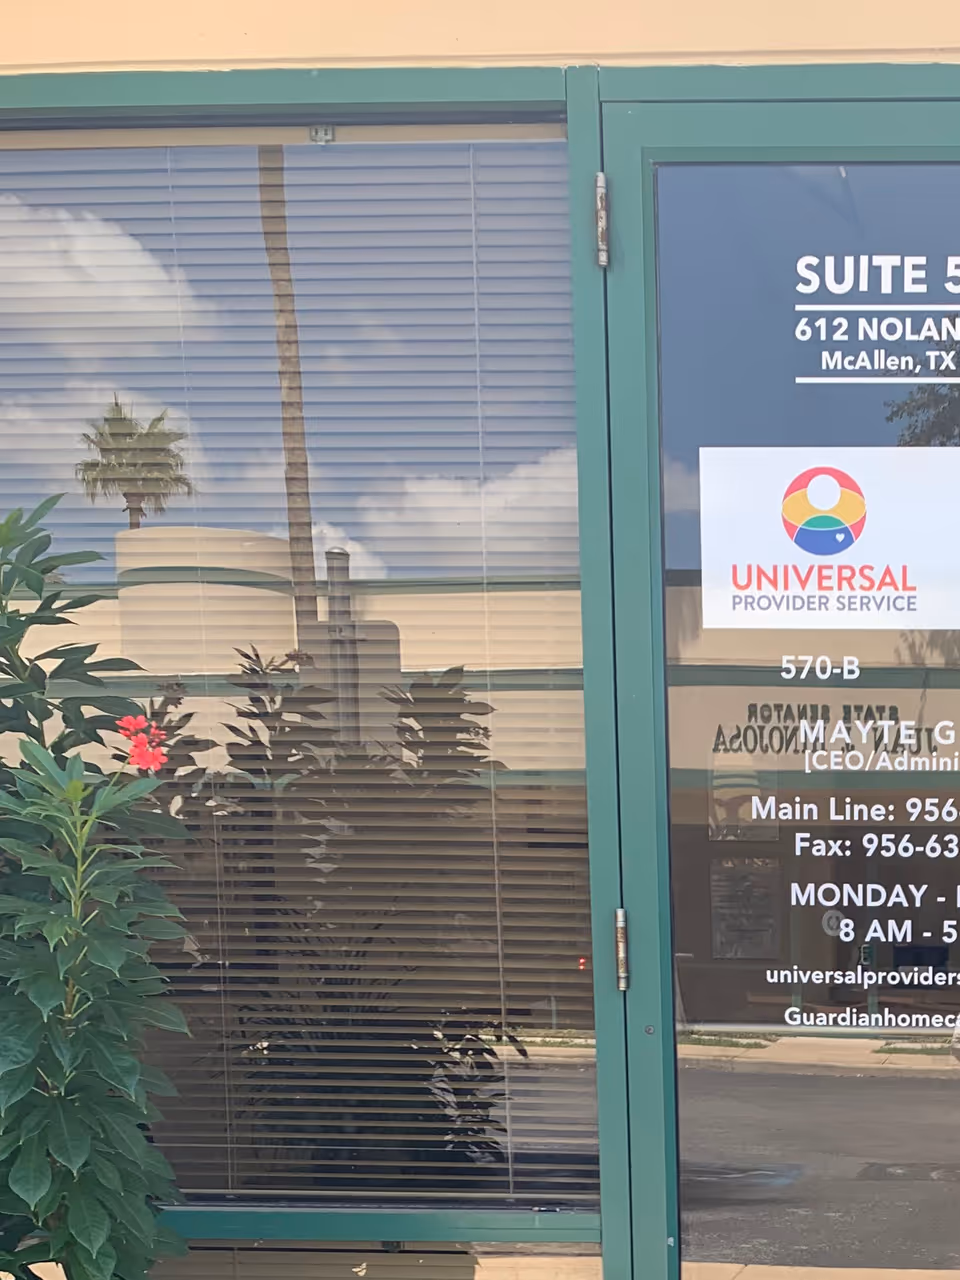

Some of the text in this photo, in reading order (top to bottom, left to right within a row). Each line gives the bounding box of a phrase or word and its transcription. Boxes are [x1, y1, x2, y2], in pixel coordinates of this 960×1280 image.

[795, 255, 928, 294] SUITE
[794, 318, 849, 342] 612
[821, 351, 921, 374] McAllen,
[926, 351, 957, 371] TX
[731, 564, 917, 592] UNIVERSAL
[732, 595, 917, 612] PROVIDER SERVICE
[780, 655, 860, 681] 570-B
[799, 720, 918, 745] MAYTE
[750, 796, 819, 821] Main
[829, 797, 895, 821] Line:
[794, 833, 852, 858] Fax:
[790, 883, 928, 908] MONDAY
[838, 918, 855, 942] 8
[865, 919, 912, 942] AM
[941, 920, 958, 944] 5
